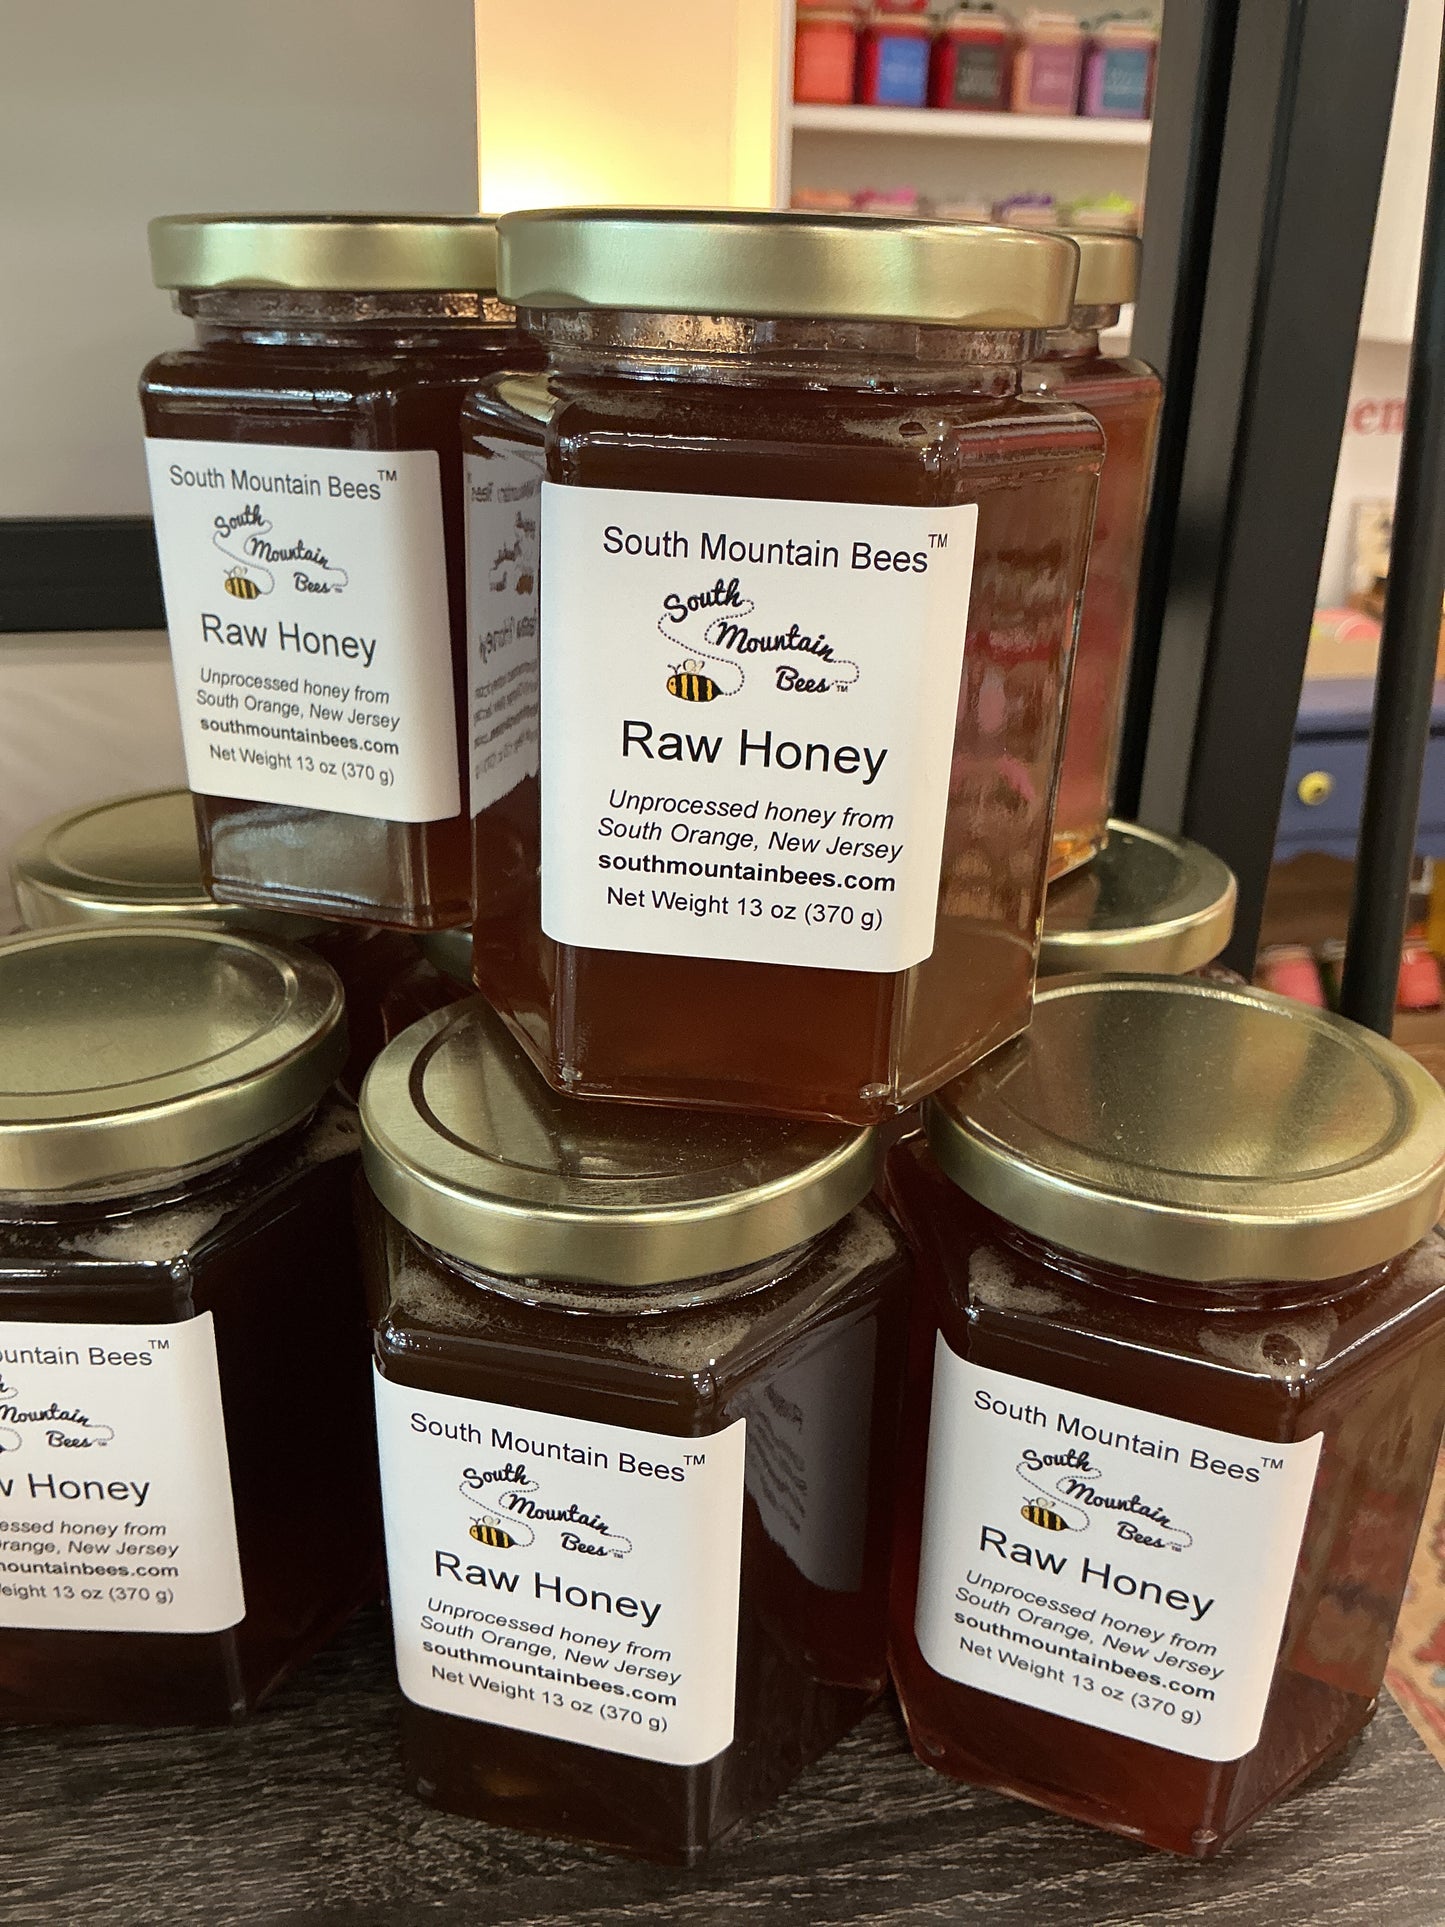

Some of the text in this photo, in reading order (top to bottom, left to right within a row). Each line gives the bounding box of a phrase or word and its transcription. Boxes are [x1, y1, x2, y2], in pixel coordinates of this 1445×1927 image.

[170, 465, 225, 488] South
[231, 469, 321, 496] Mountain
[214, 504, 266, 537] South
[249, 537, 332, 568] Mountain
[603, 526, 688, 558] South
[701, 532, 838, 568] Mountain
[293, 571, 330, 594] Bees
[664, 578, 743, 622] South
[201, 613, 376, 668] Raw Honey
[715, 624, 835, 663] Mountain
[201, 668, 389, 704] Unprocessed honey from
[776, 666, 830, 693] Bees
[197, 689, 400, 732] South Orange, New Jersey
[200, 718, 400, 755] southmountainbees.com
[623, 720, 888, 785] Raw Honey
[210, 744, 394, 786] Net Weight 13 oz (370 g)
[609, 789, 894, 831] Unprocessed honey from
[598, 817, 903, 863] South Orange, New Jersey
[599, 854, 895, 891] southmountainbees.com
[608, 886, 882, 931] Net Weight 13 oz (370 g)
[0, 1346, 79, 1365] untain
[46, 1430, 92, 1448] Bees
[411, 1413, 481, 1444] South
[492, 1428, 608, 1469] Mountain
[974, 1390, 1047, 1427] South
[1057, 1413, 1179, 1463] Mountain
[463, 1463, 530, 1489] South
[1022, 1449, 1092, 1471] South
[28, 1473, 150, 1507] Honey
[1066, 1478, 1172, 1528] Mountain
[60, 1521, 119, 1538] honey
[124, 1522, 166, 1536] from
[508, 1494, 612, 1536] Mountain
[1117, 1522, 1166, 1549] Bees
[0, 1540, 179, 1558] range, New Jersey
[560, 1533, 608, 1557] Bees
[0, 1562, 179, 1577] ountainbees.com
[435, 1550, 661, 1628] Raw Honey
[980, 1525, 1215, 1621] Raw Honey
[0, 1583, 173, 1604] eight 13 oz (370 g)
[966, 1569, 1217, 1656] Unprocessed honey from
[428, 1597, 671, 1662] Unprocessed honey from
[955, 1587, 1224, 1680] South Orange, New Jersey
[421, 1616, 682, 1686] South Orange, New Jersey
[954, 1612, 1215, 1701] southmountainbees.com
[423, 1640, 677, 1707] southmountainbees.com
[960, 1636, 1201, 1725] Net Weight 13 oz (370 g)
[432, 1665, 667, 1733] Net Weight 13 oz (370 g)
